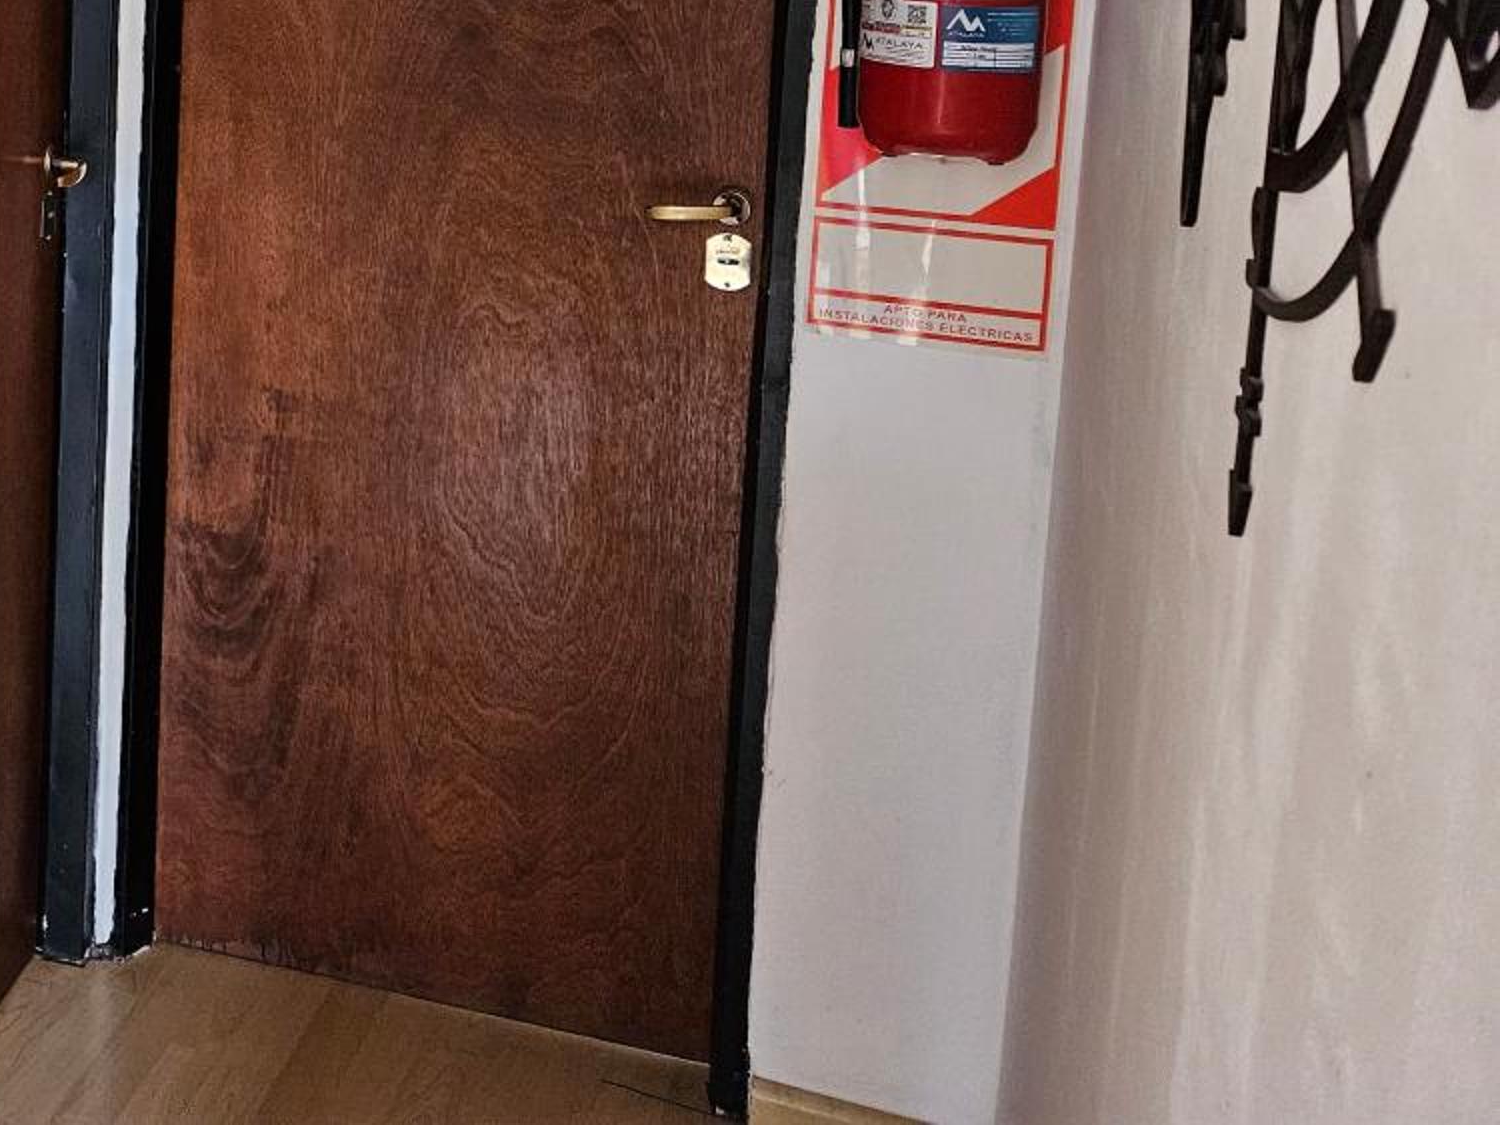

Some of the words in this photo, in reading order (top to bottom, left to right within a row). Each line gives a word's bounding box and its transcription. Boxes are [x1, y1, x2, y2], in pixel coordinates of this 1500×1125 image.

[875, 36, 924, 50] ATALAYA
[884, 304, 924, 317] APTO
[927, 311, 967, 324] PARA
[819, 308, 935, 331] INSTALACIONES
[939, 322, 1033, 342] ELECTRICAS
